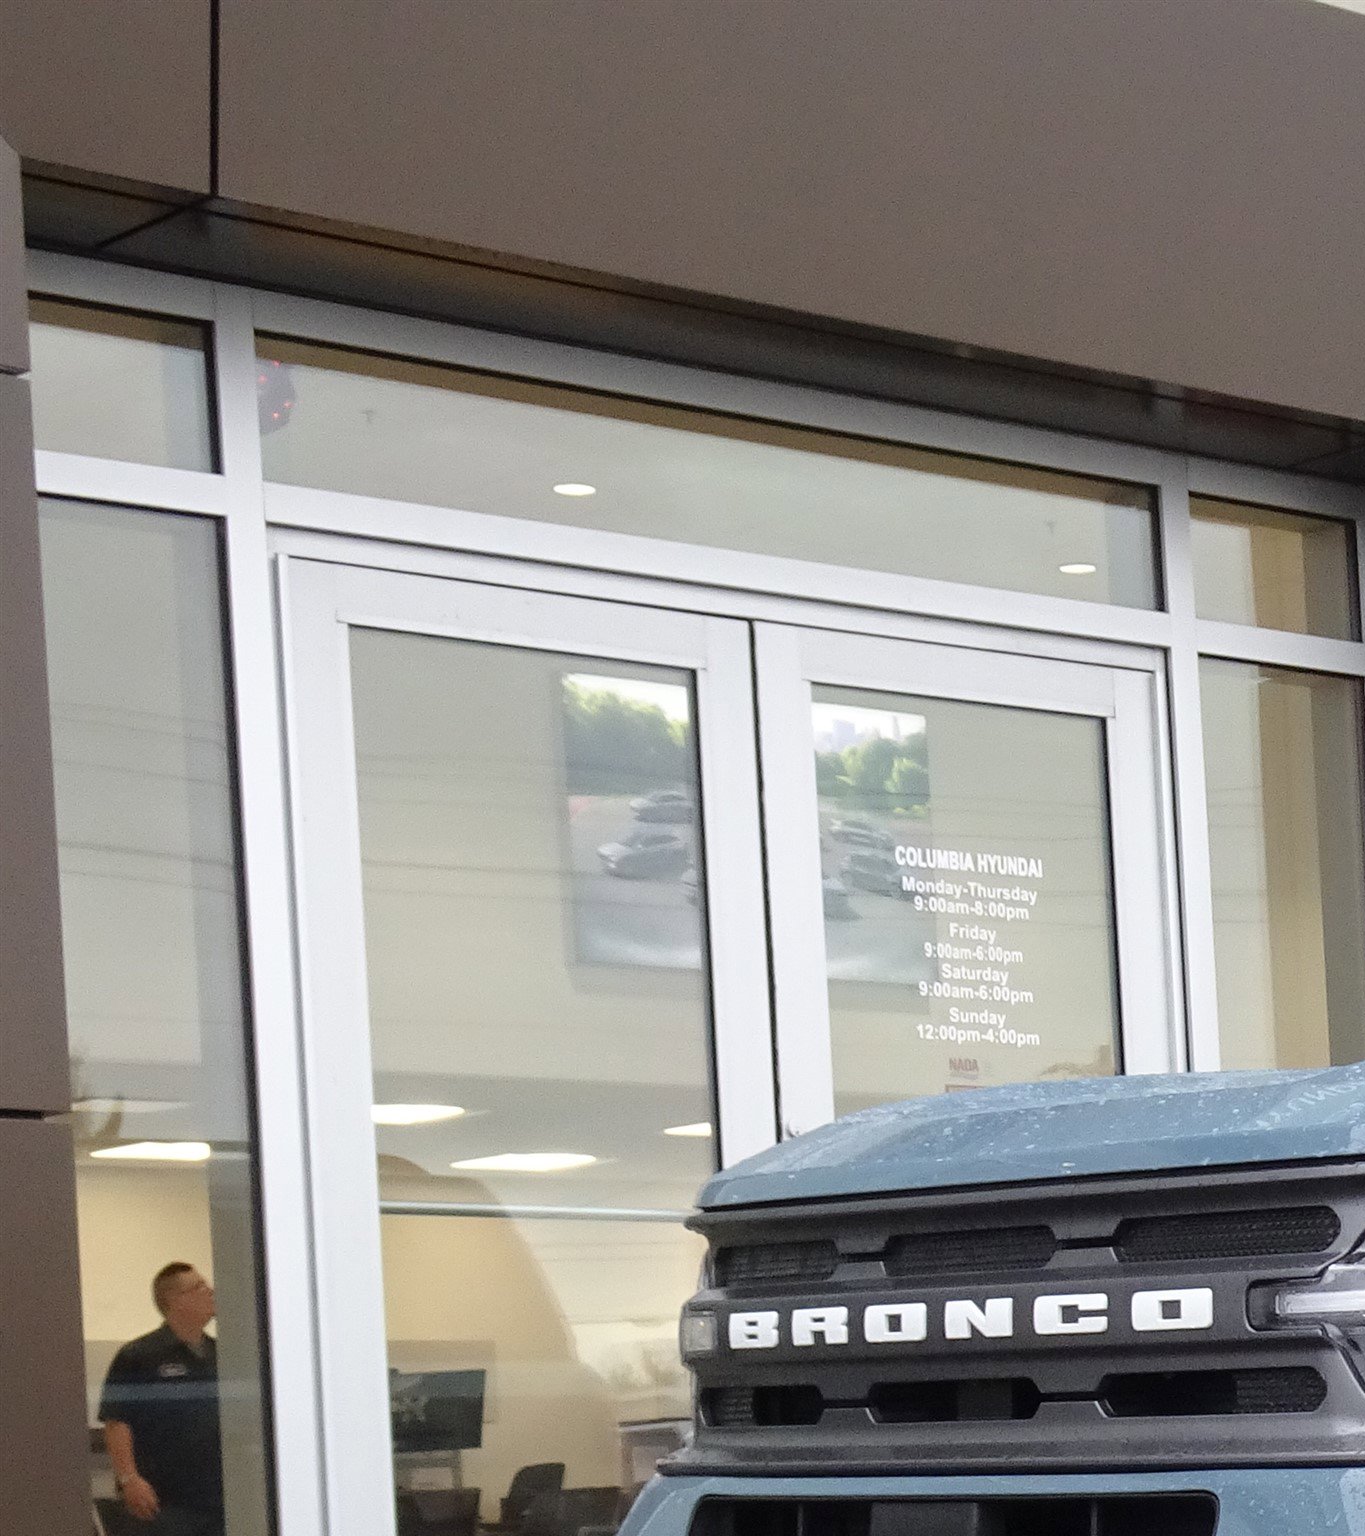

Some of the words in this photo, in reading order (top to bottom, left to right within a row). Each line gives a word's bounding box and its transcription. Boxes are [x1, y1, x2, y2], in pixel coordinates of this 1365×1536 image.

[895, 846, 975, 871] COLUMBIA
[977, 853, 1043, 878] HYUNDAI
[902, 876, 1037, 906] Monday-Thursday
[914, 896, 1030, 921] 9:00am-8:00pm
[949, 923, 997, 945] Friday
[924, 942, 1024, 964] 9:00am-6:00pm
[941, 964, 1009, 986] Saturday
[918, 981, 1034, 1005] 9:00am-6:00pm
[949, 1007, 1006, 1029] Sunday
[916, 1024, 1041, 1047] 12:00pm-4:00pm
[728, 1287, 1213, 1349] BRONCO
